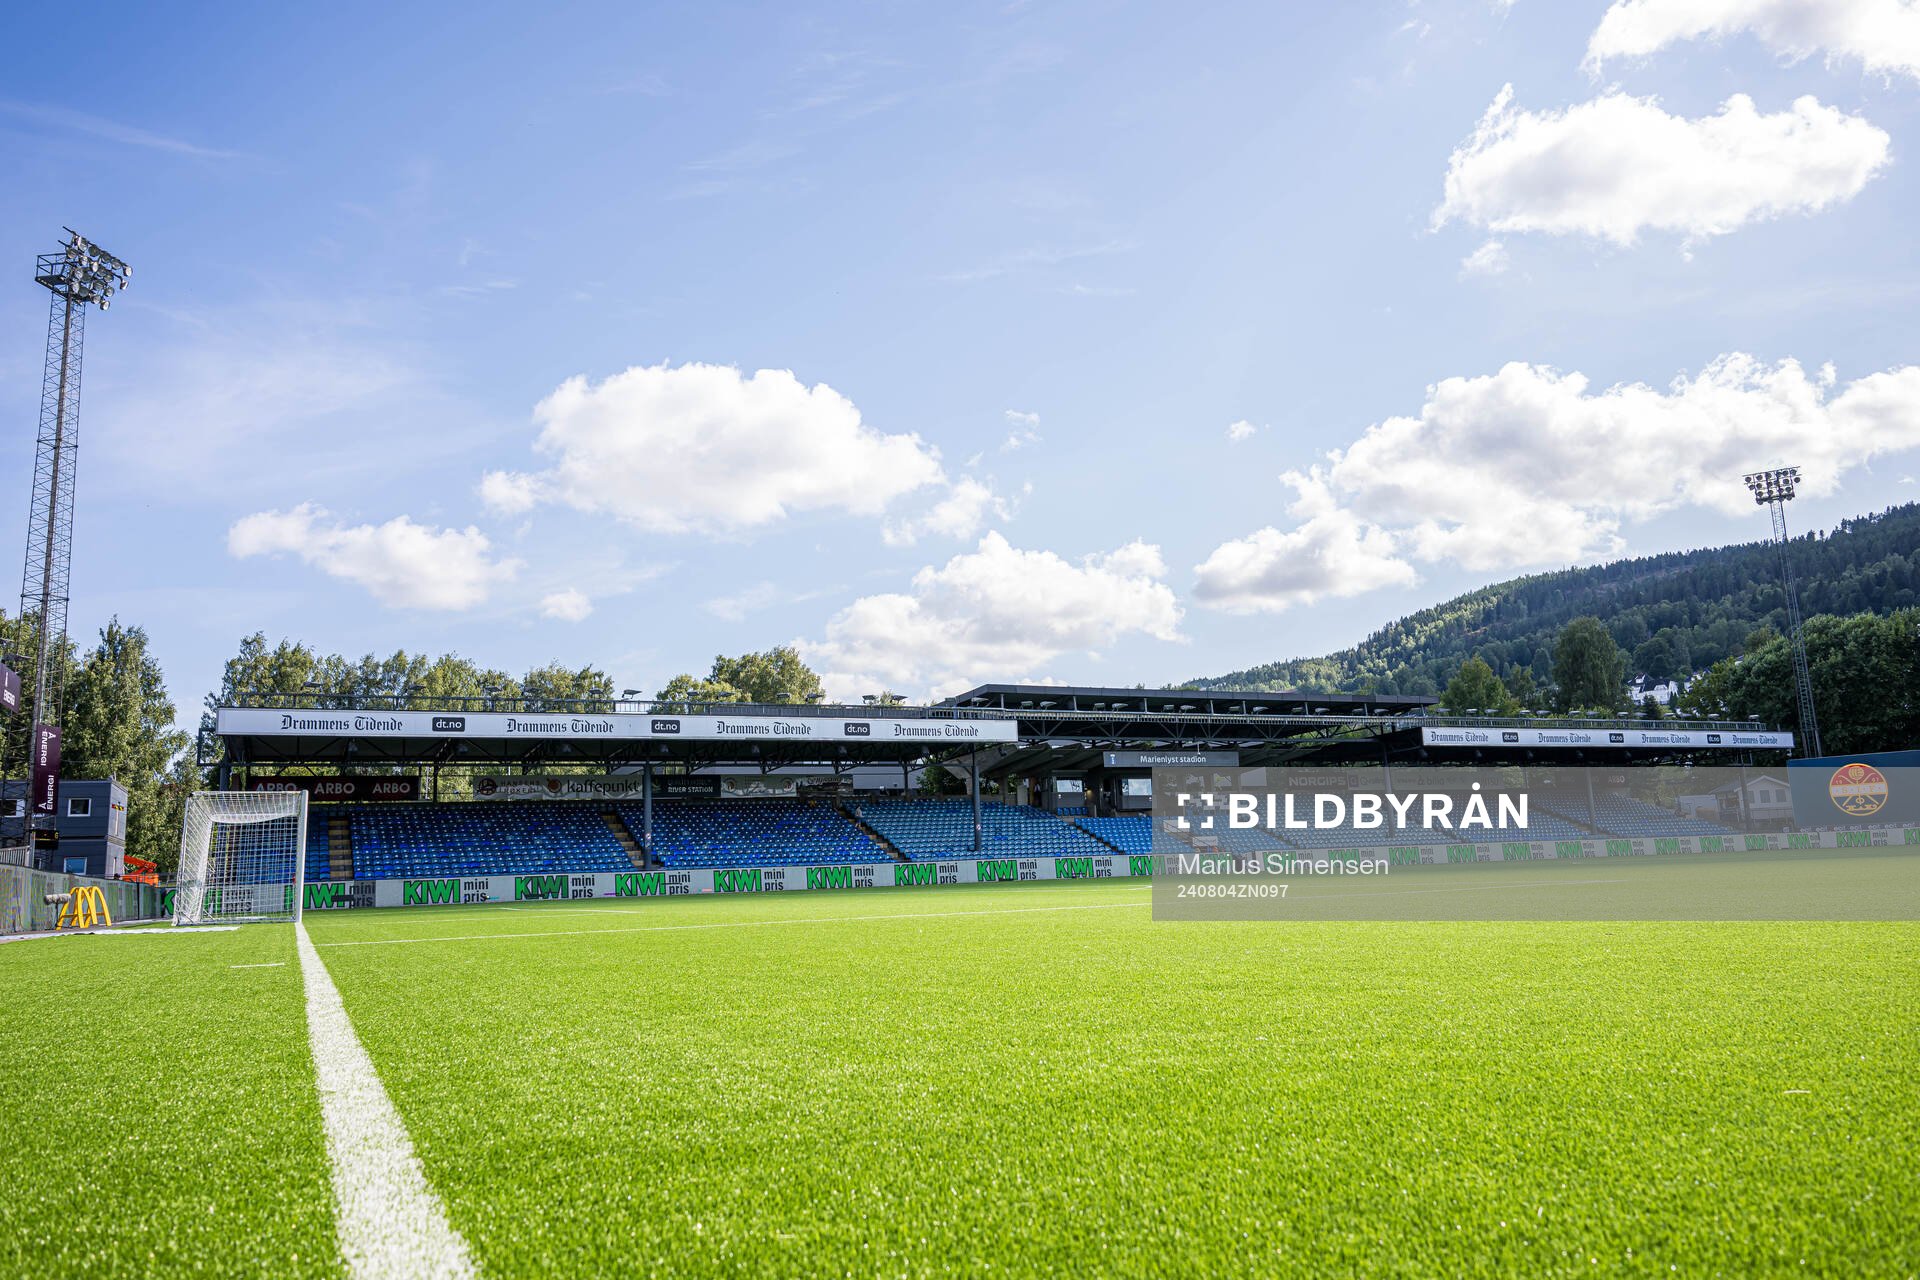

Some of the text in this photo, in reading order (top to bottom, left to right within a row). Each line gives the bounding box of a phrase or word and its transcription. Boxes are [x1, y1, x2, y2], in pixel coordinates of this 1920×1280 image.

[281, 714, 403, 732] Drammens Tidende
[436, 718, 462, 729] dt.no
[507, 718, 614, 734] Drammens Tidende
[654, 721, 678, 732] dt.no
[716, 720, 812, 736] Drammens Tidende
[847, 724, 868, 734] dt.no
[894, 724, 979, 737] Drammens Tidende
[1430, 731, 1489, 742] Drammens Tidende
[1140, 755, 1178, 764] Marienlyst
[256, 782, 297, 791] ARBO
[567, 779, 639, 795] kaffepunkt
[1289, 776, 1346, 786] NORGIPS
[314, 782, 355, 794] ARBO
[372, 782, 410, 793] ARBO
[1836, 831, 1871, 848] KIWI
[1873, 838, 1888, 846] pris
[1502, 843, 1531, 861] KIWI
[1555, 841, 1583, 858] KIWI
[1605, 839, 1632, 857] KIWI
[1654, 838, 1680, 855] KIWI
[1388, 847, 1420, 865] KIWI
[1446, 845, 1477, 863] KIWI
[939, 862, 958, 873] mini
[1019, 859, 1037, 870] mini
[1055, 857, 1094, 878] KIWI
[1095, 857, 1112, 867] mini
[1129, 855, 1166, 876] KIWI
[764, 869, 785, 879] mini
[854, 866, 874, 876] mini
[894, 863, 937, 886] KIWI
[977, 860, 1018, 881] KIWI
[1020, 870, 1036, 880] pris
[1096, 867, 1111, 878] pris
[572, 875, 594, 886] mini
[669, 872, 691, 883] mini
[713, 869, 762, 892] KIWI
[806, 866, 852, 889] KIWI
[855, 877, 873, 888] pris
[940, 874, 957, 884] pris
[351, 882, 375, 895] mini
[464, 878, 489, 890] mini
[515, 875, 568, 900] KIWI
[615, 872, 666, 896] KIWI
[669, 883, 689, 895] pris
[764, 880, 783, 891] pris
[284, 882, 345, 910] IWI
[403, 879, 461, 905] KIWI
[464, 891, 487, 904] pris
[572, 887, 593, 899] pris
